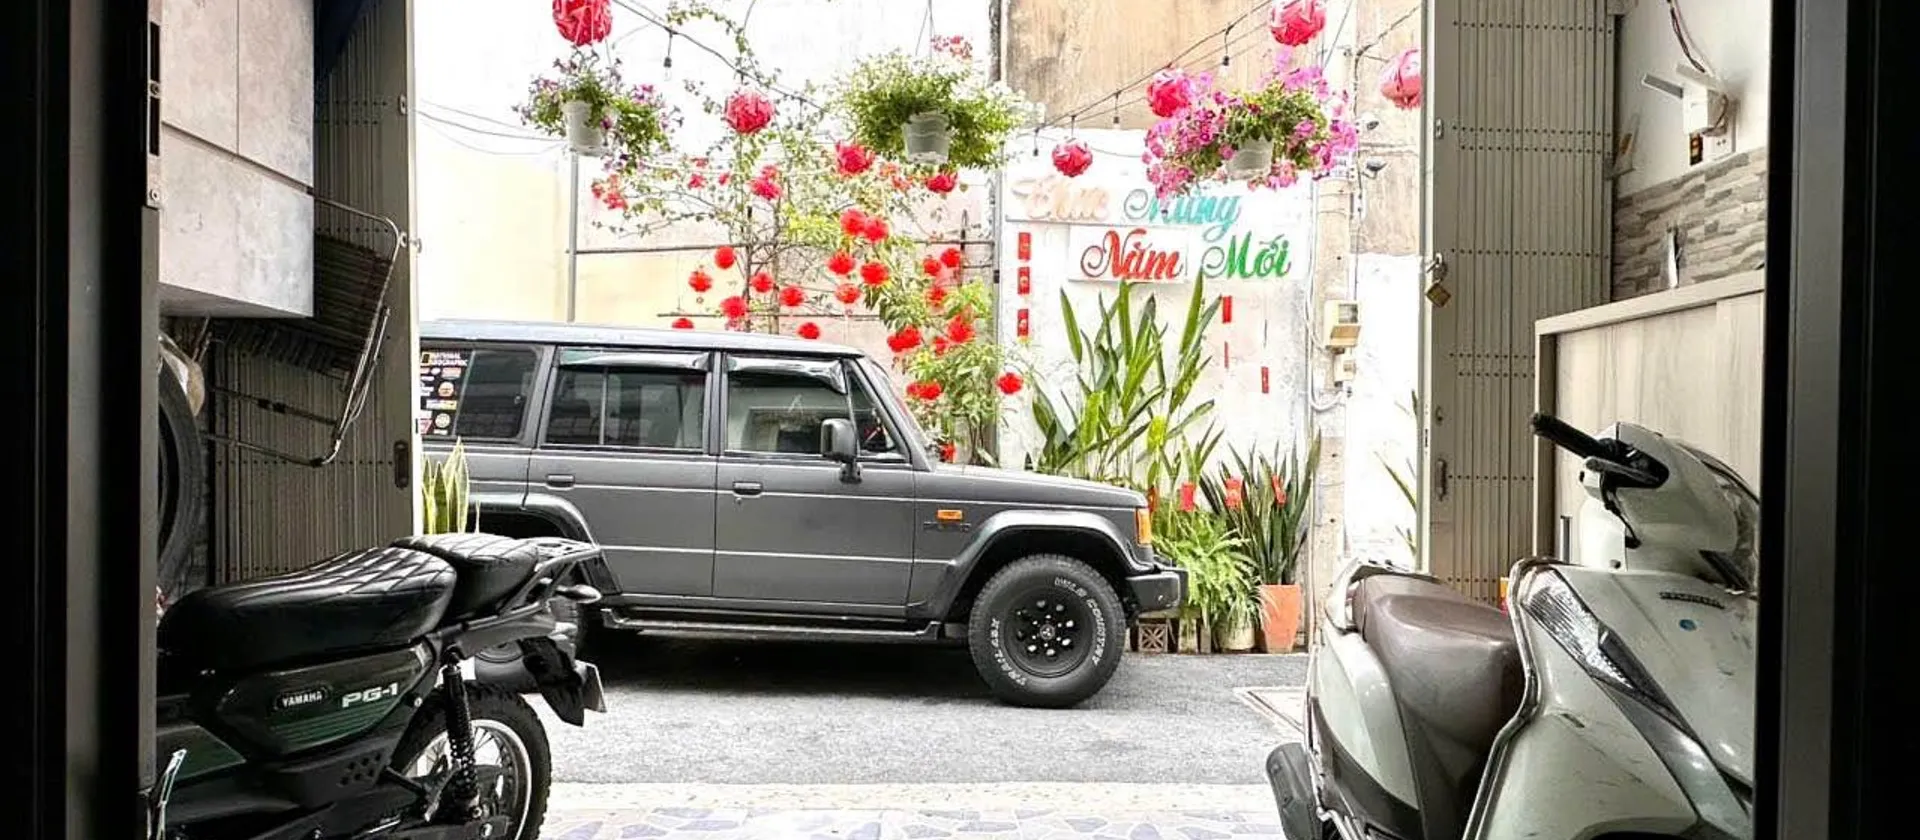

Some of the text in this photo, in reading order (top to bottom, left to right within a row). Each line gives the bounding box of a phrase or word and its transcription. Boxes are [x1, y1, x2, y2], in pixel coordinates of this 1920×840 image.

[1080, 228, 1291, 280] Năm Mới
[1086, 598, 1106, 666] COUNTRY
[994, 649, 1027, 686] TRAIL
[282, 690, 323, 708] YAMAHA
[342, 682, 398, 708] PG-1
